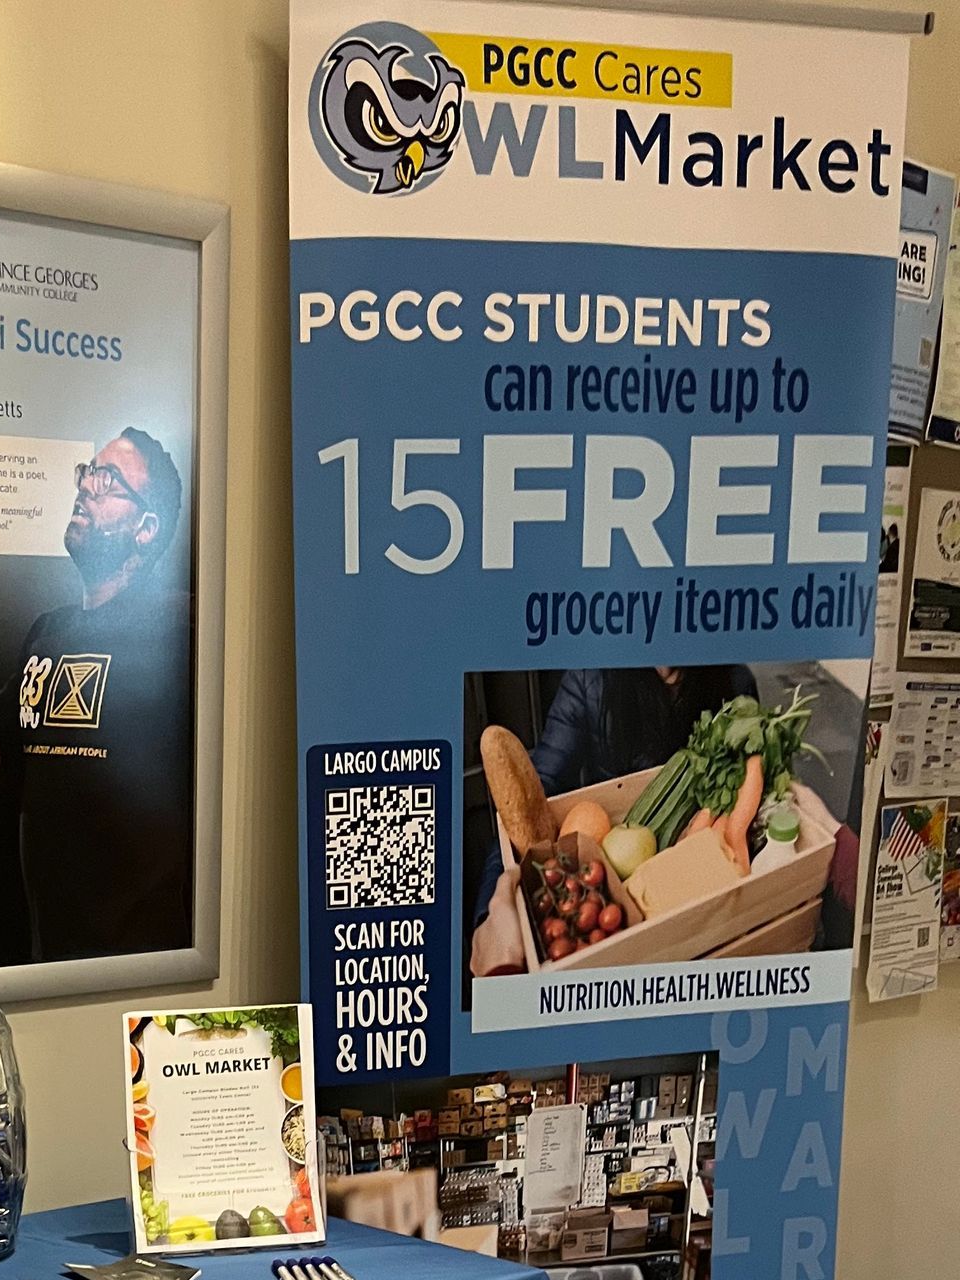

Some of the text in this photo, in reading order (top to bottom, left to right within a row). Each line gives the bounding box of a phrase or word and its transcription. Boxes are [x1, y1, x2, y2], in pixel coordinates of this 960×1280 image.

[483, 44, 703, 99] PGCC Cares
[901, 241, 927, 262] ARE
[34, 266, 99, 291] GEORGE'S
[43, 288, 78, 302] COLLEGE
[299, 289, 772, 347] PGCC STUDENTS
[16, 318, 123, 362] Success
[484, 353, 810, 423] can receive up to
[27, 456, 38, 465] an
[1, 506, 43, 519] meaningful
[482, 434, 875, 569] FREE
[526, 573, 874, 647] grocery items daily
[79, 748, 108, 759] PEOPLE
[324, 748, 441, 776] LARGO CAMPUS
[334, 918, 425, 951] SCAN FOR
[335, 954, 430, 987] LOCATION,
[336, 985, 428, 1028] HOURS
[162, 1057, 271, 1078] OWL MARKET
[193, 1047, 245, 1058] PGCC CARES
[336, 1029, 427, 1073] & INFO
